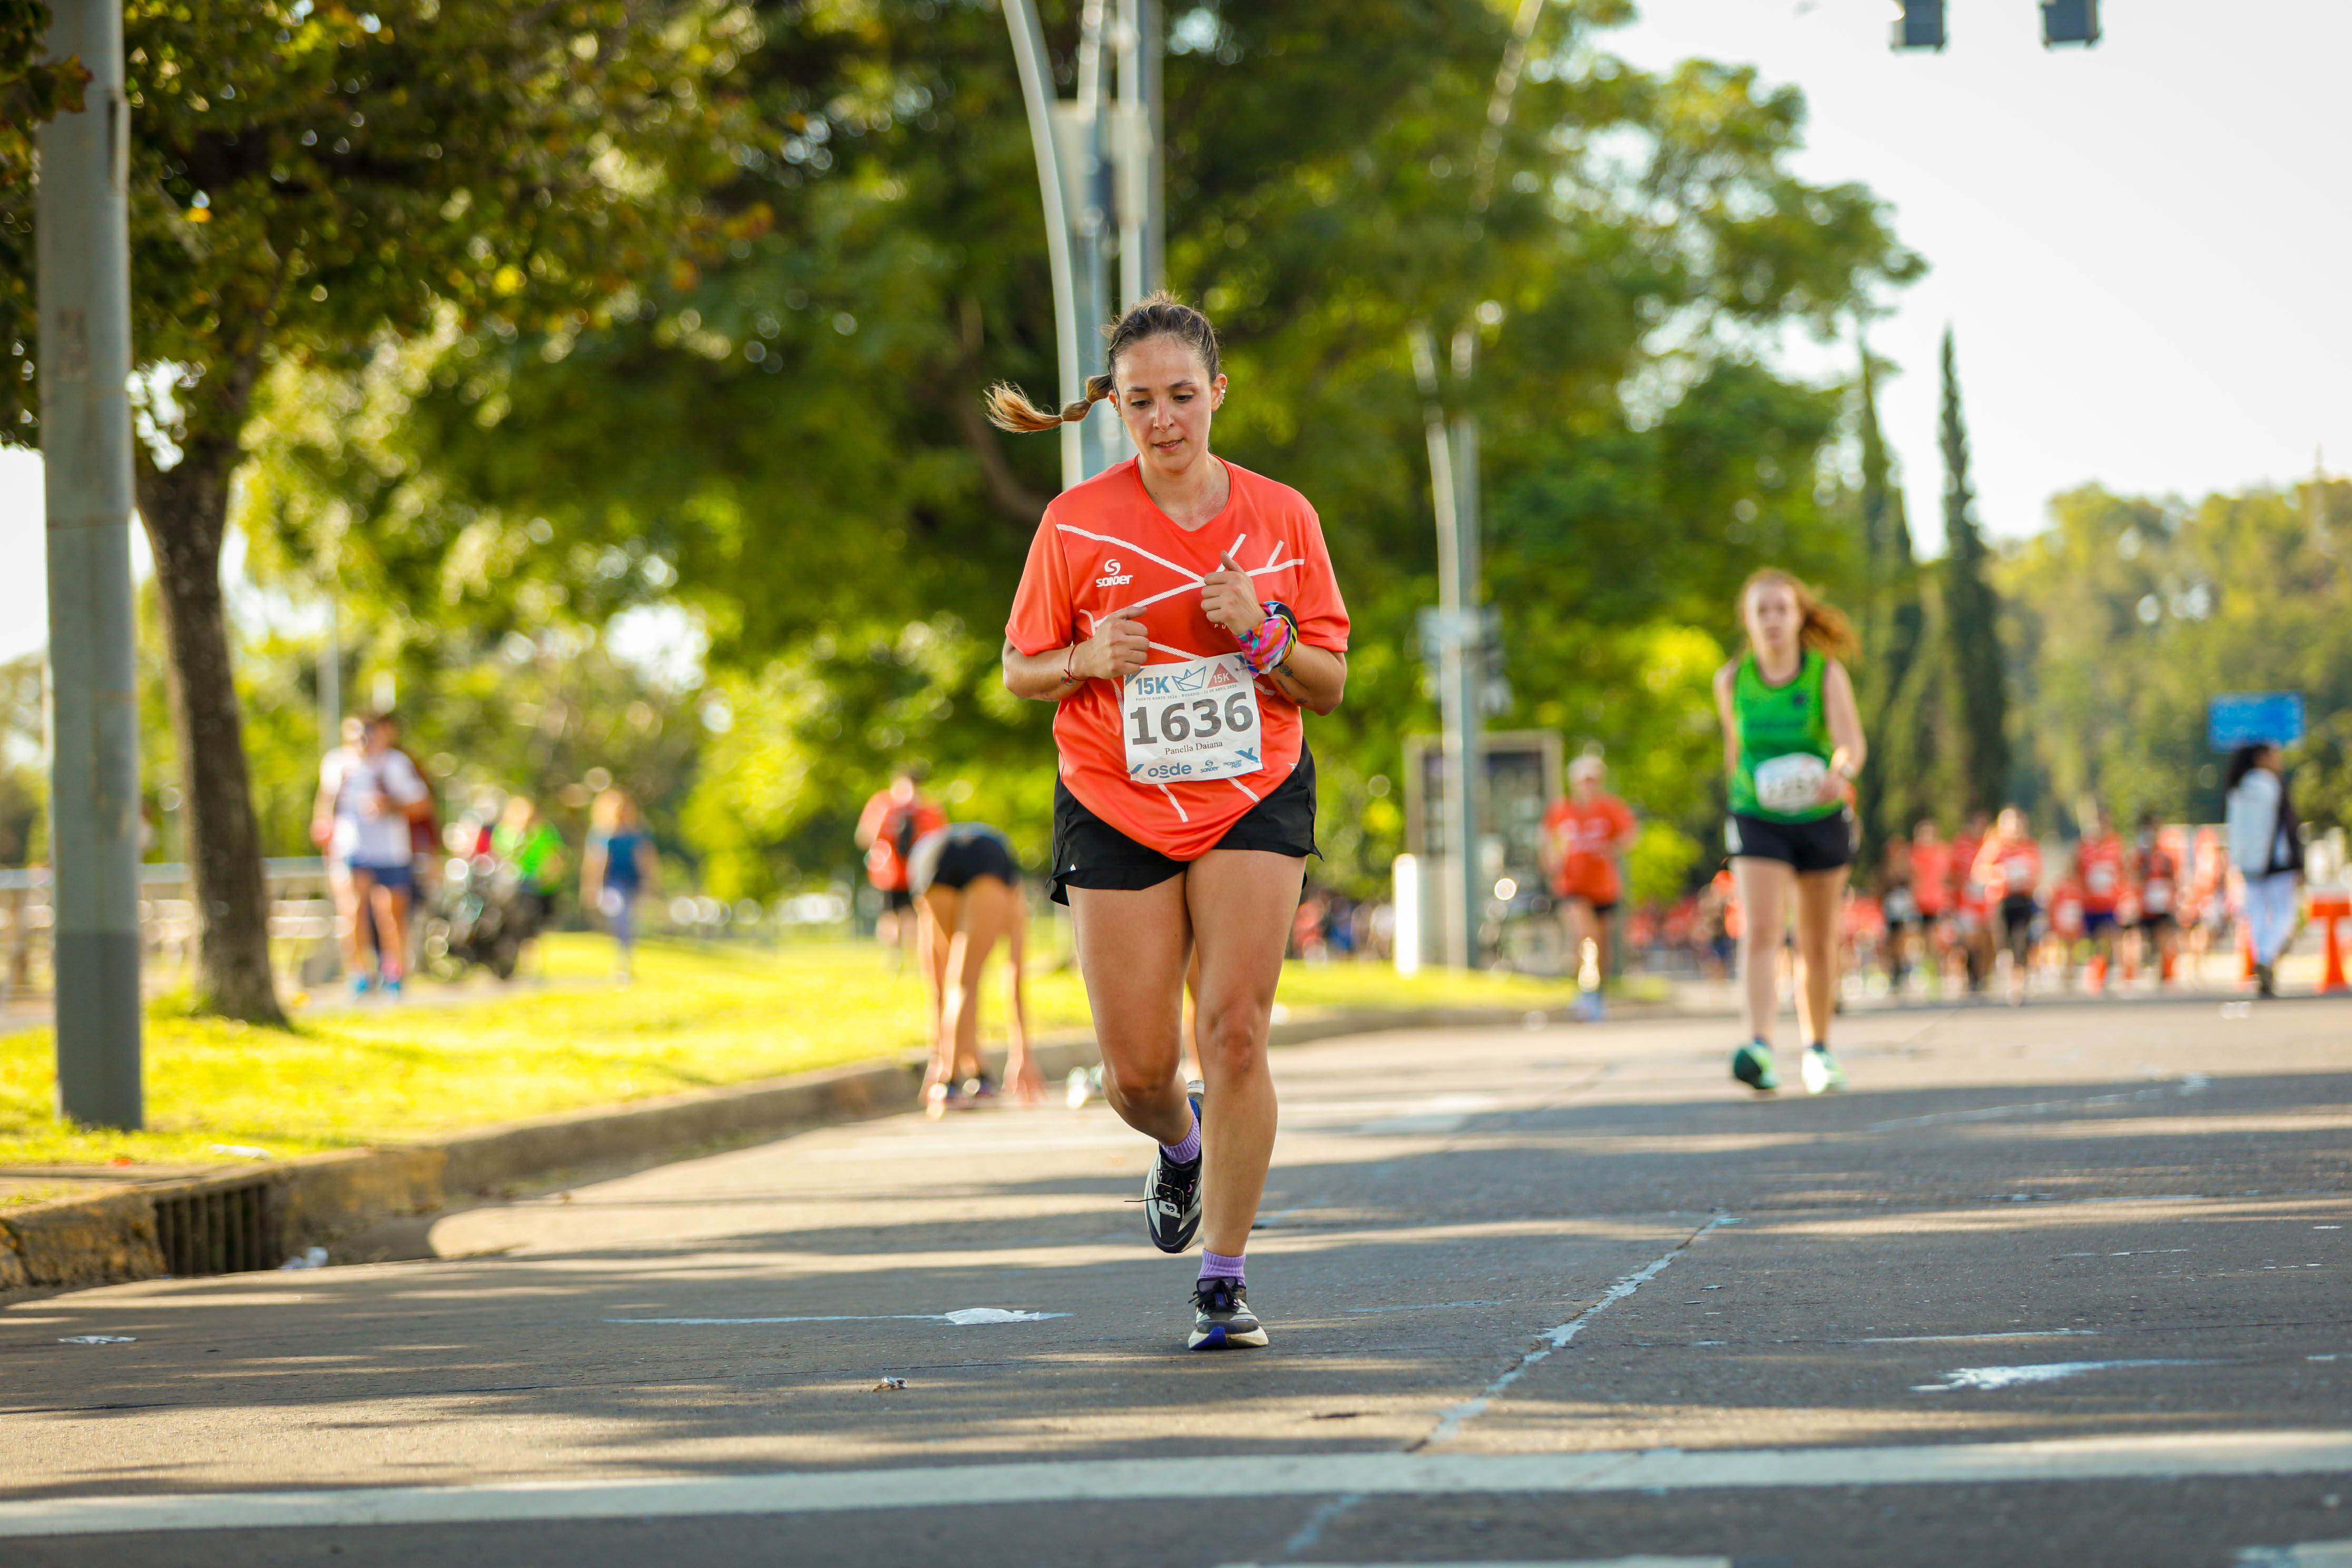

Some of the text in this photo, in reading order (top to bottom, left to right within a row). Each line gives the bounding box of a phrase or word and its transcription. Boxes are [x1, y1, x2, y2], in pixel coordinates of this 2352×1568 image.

[1135, 676, 1170, 695] 15K
[1213, 672, 1230, 684] 15K
[1130, 691, 1254, 746] 1636
[1165, 740, 1223, 755] Panella Daiana
[1148, 762, 1192, 778] osde
